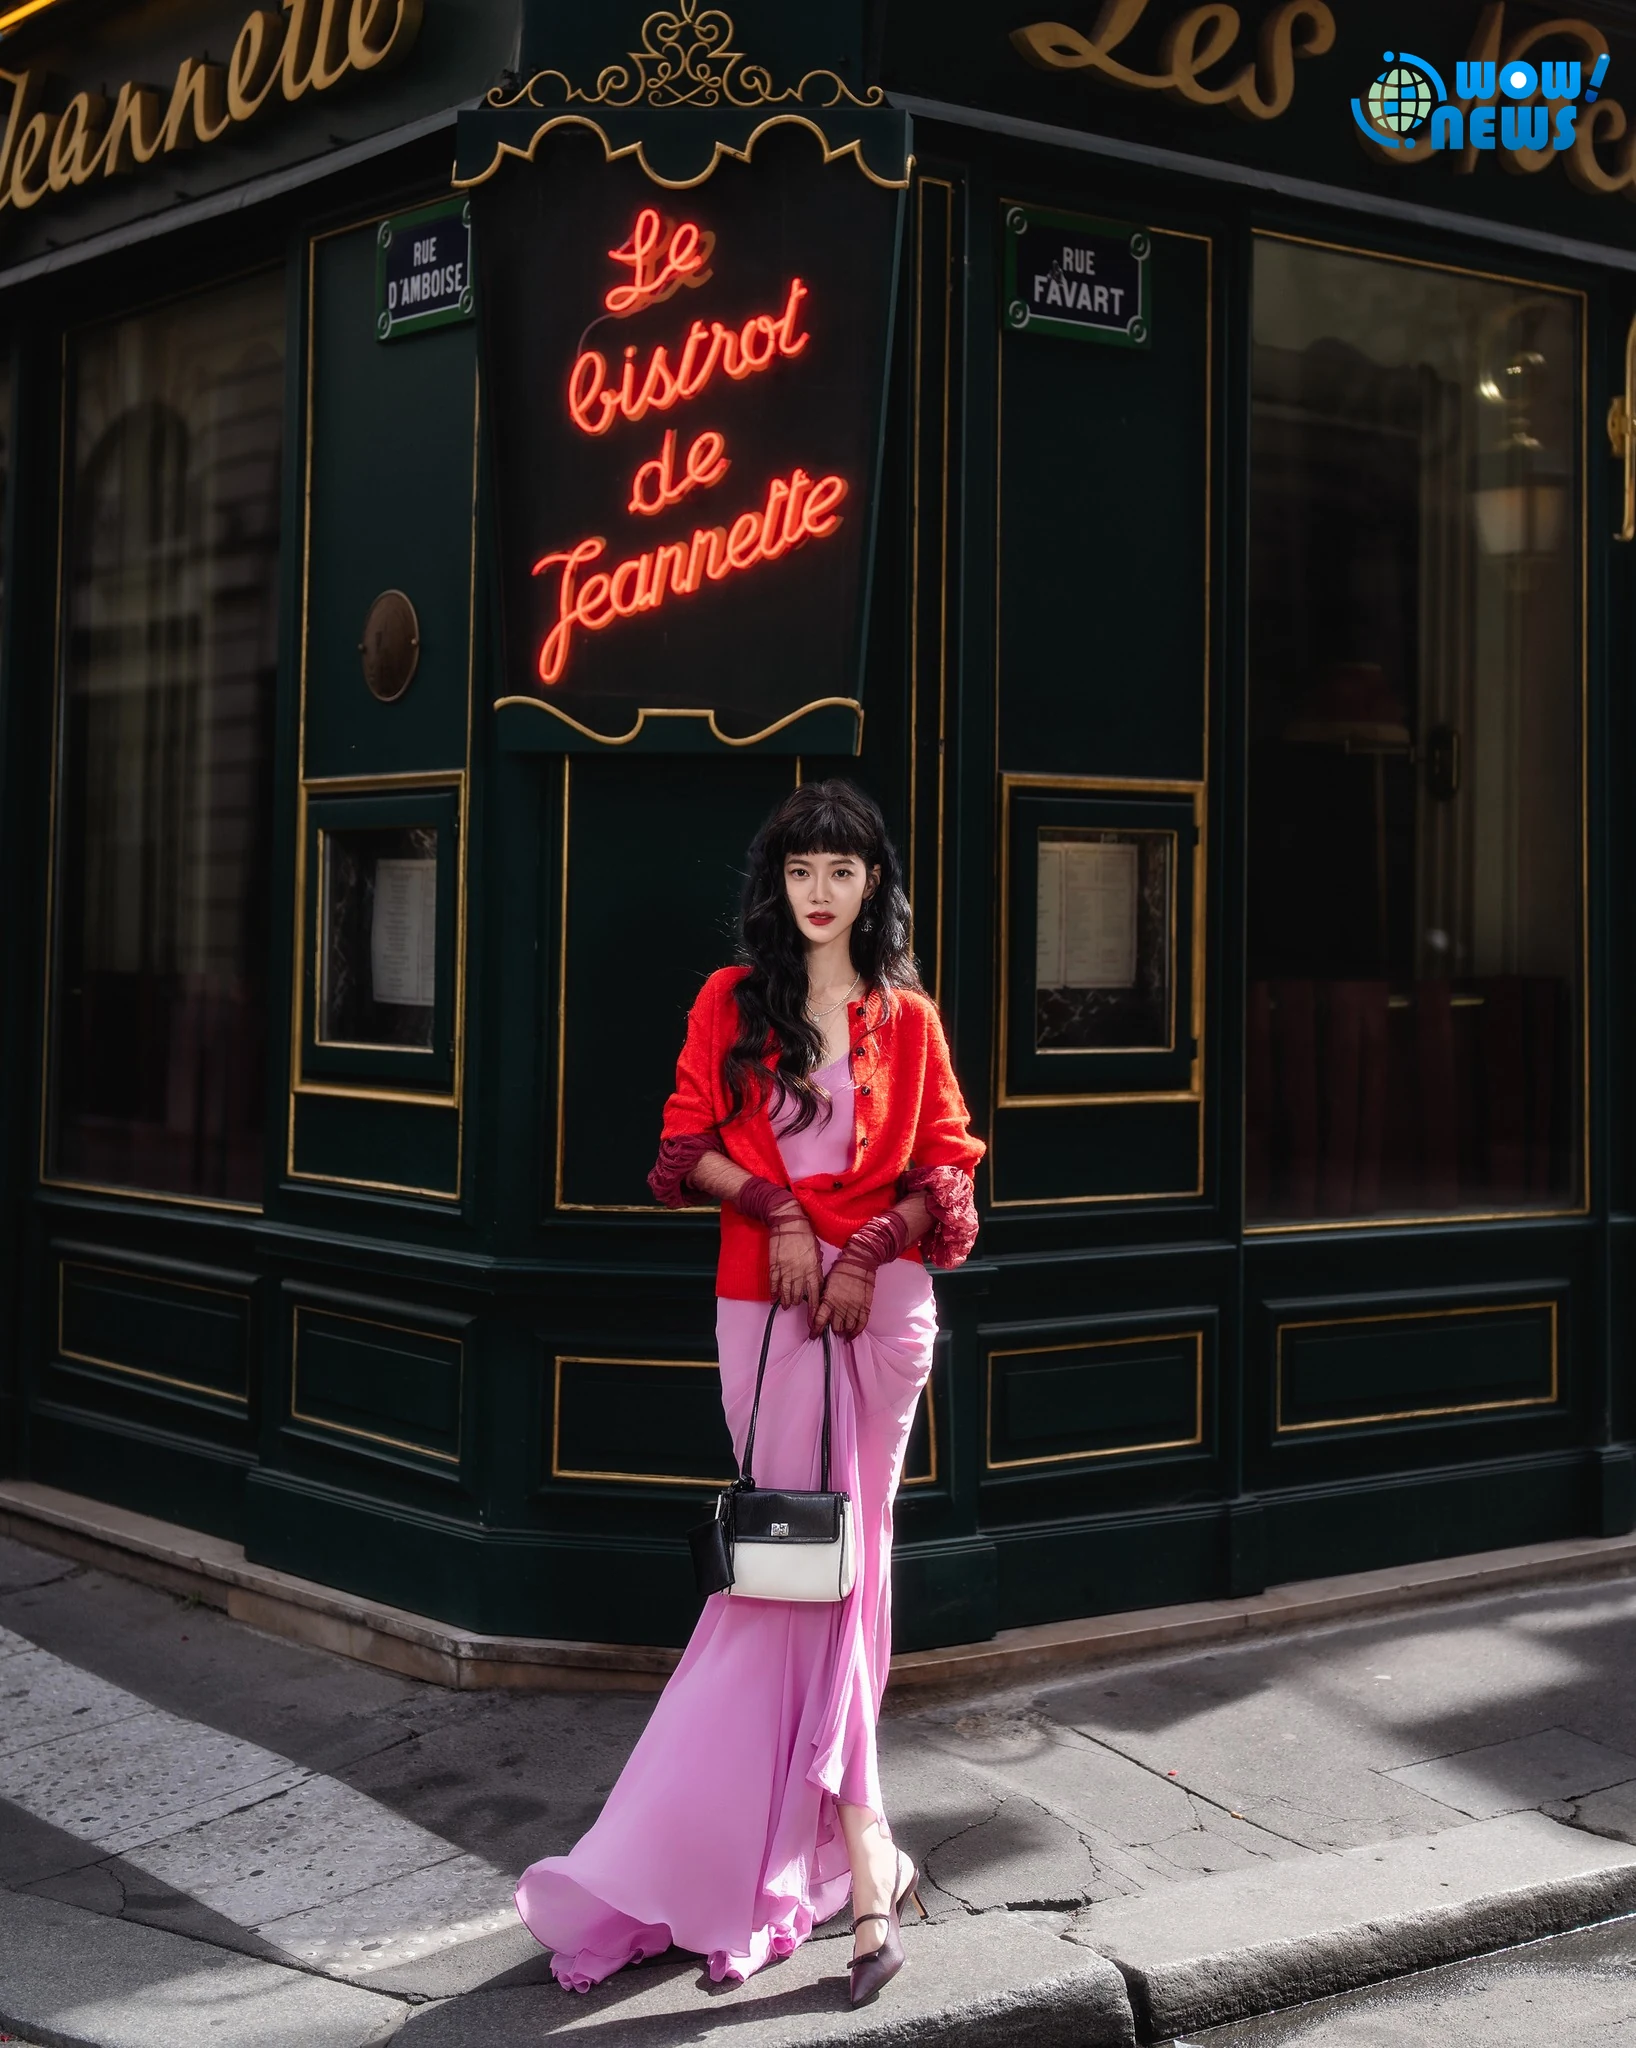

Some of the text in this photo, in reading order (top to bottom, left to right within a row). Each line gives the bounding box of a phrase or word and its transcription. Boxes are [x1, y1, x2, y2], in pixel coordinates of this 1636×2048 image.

[1009, 0, 1336, 120] Les
[387, 262, 463, 310] D'AMBOISE
[413, 236, 438, 267] RUE
[604, 207, 708, 314] Le
[1033, 274, 1125, 316] FAVART
[1062, 246, 1096, 276] RUE
[568, 277, 809, 434] bistrot
[628, 428, 731, 515] de
[530, 468, 848, 685] Jeannette
